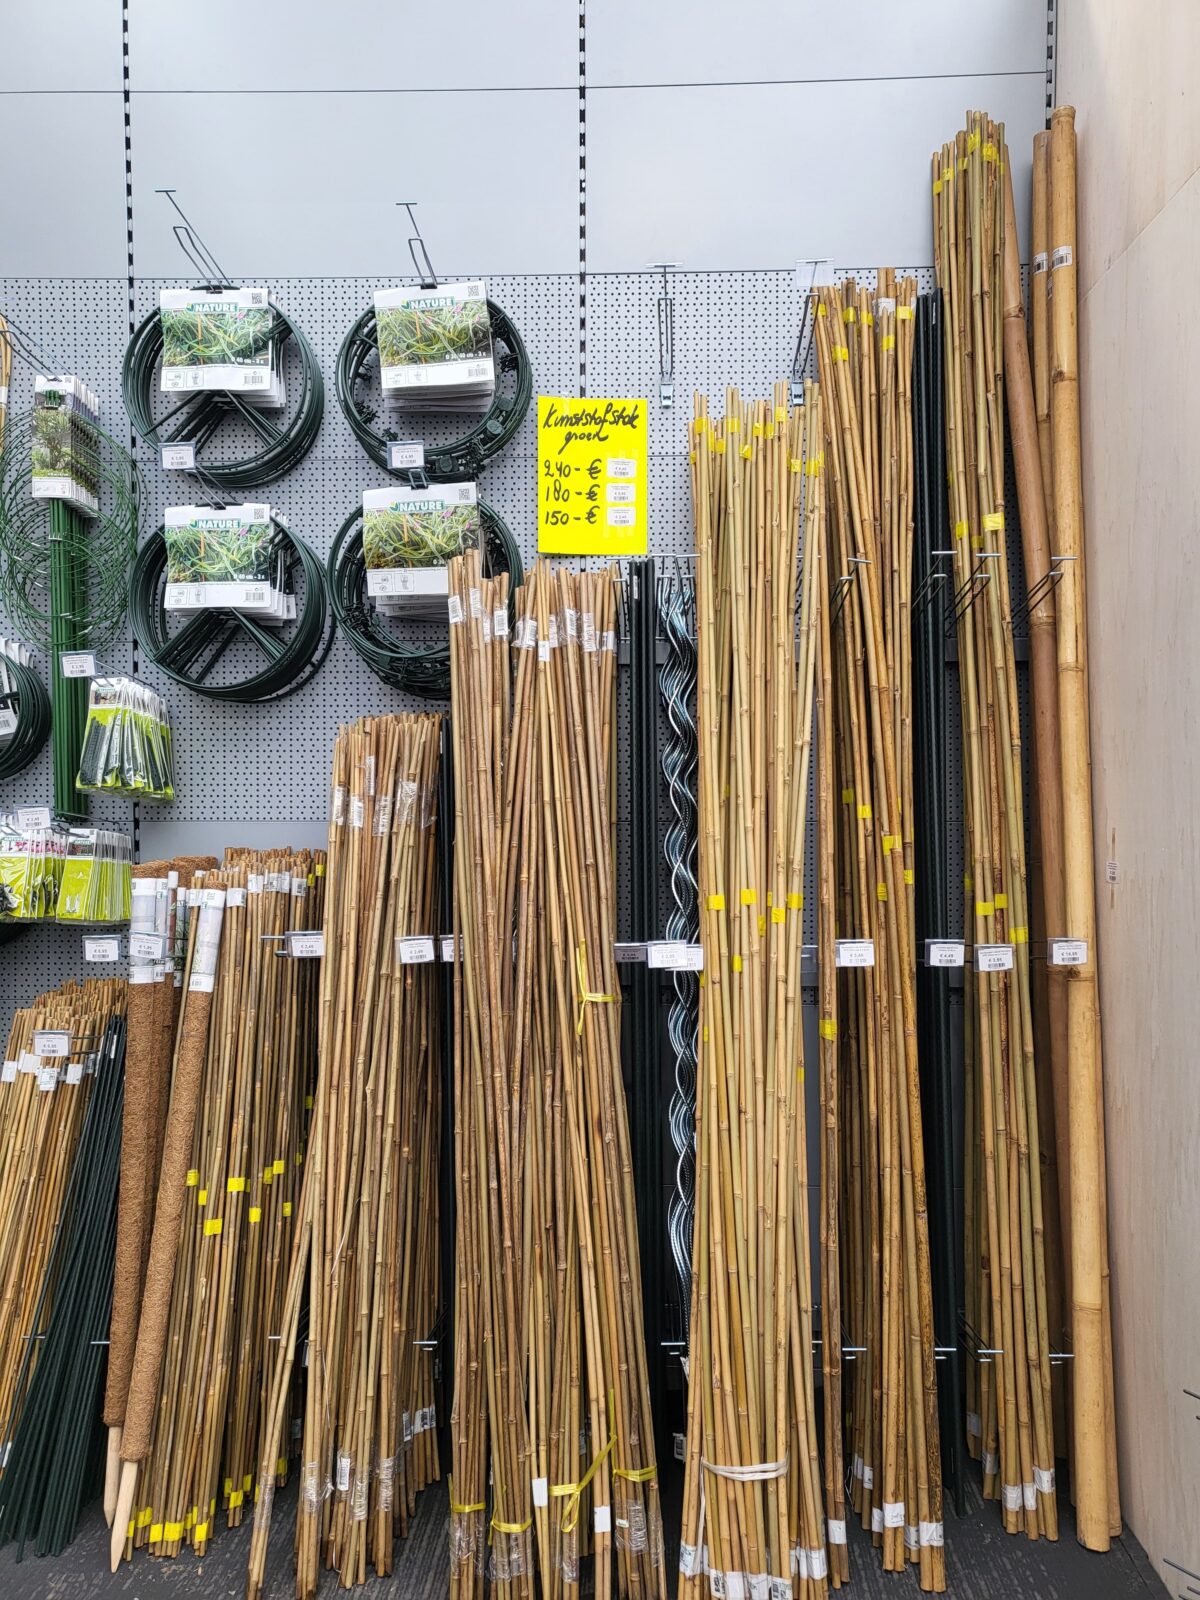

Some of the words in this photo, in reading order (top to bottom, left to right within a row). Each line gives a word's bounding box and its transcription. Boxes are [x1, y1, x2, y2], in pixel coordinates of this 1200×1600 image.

[410, 298, 452, 307] NATURE
[195, 304, 236, 312] NATURE
[557, 430, 609, 455] groen
[399, 501, 443, 511] NATURE
[198, 519, 239, 529] NATURE
